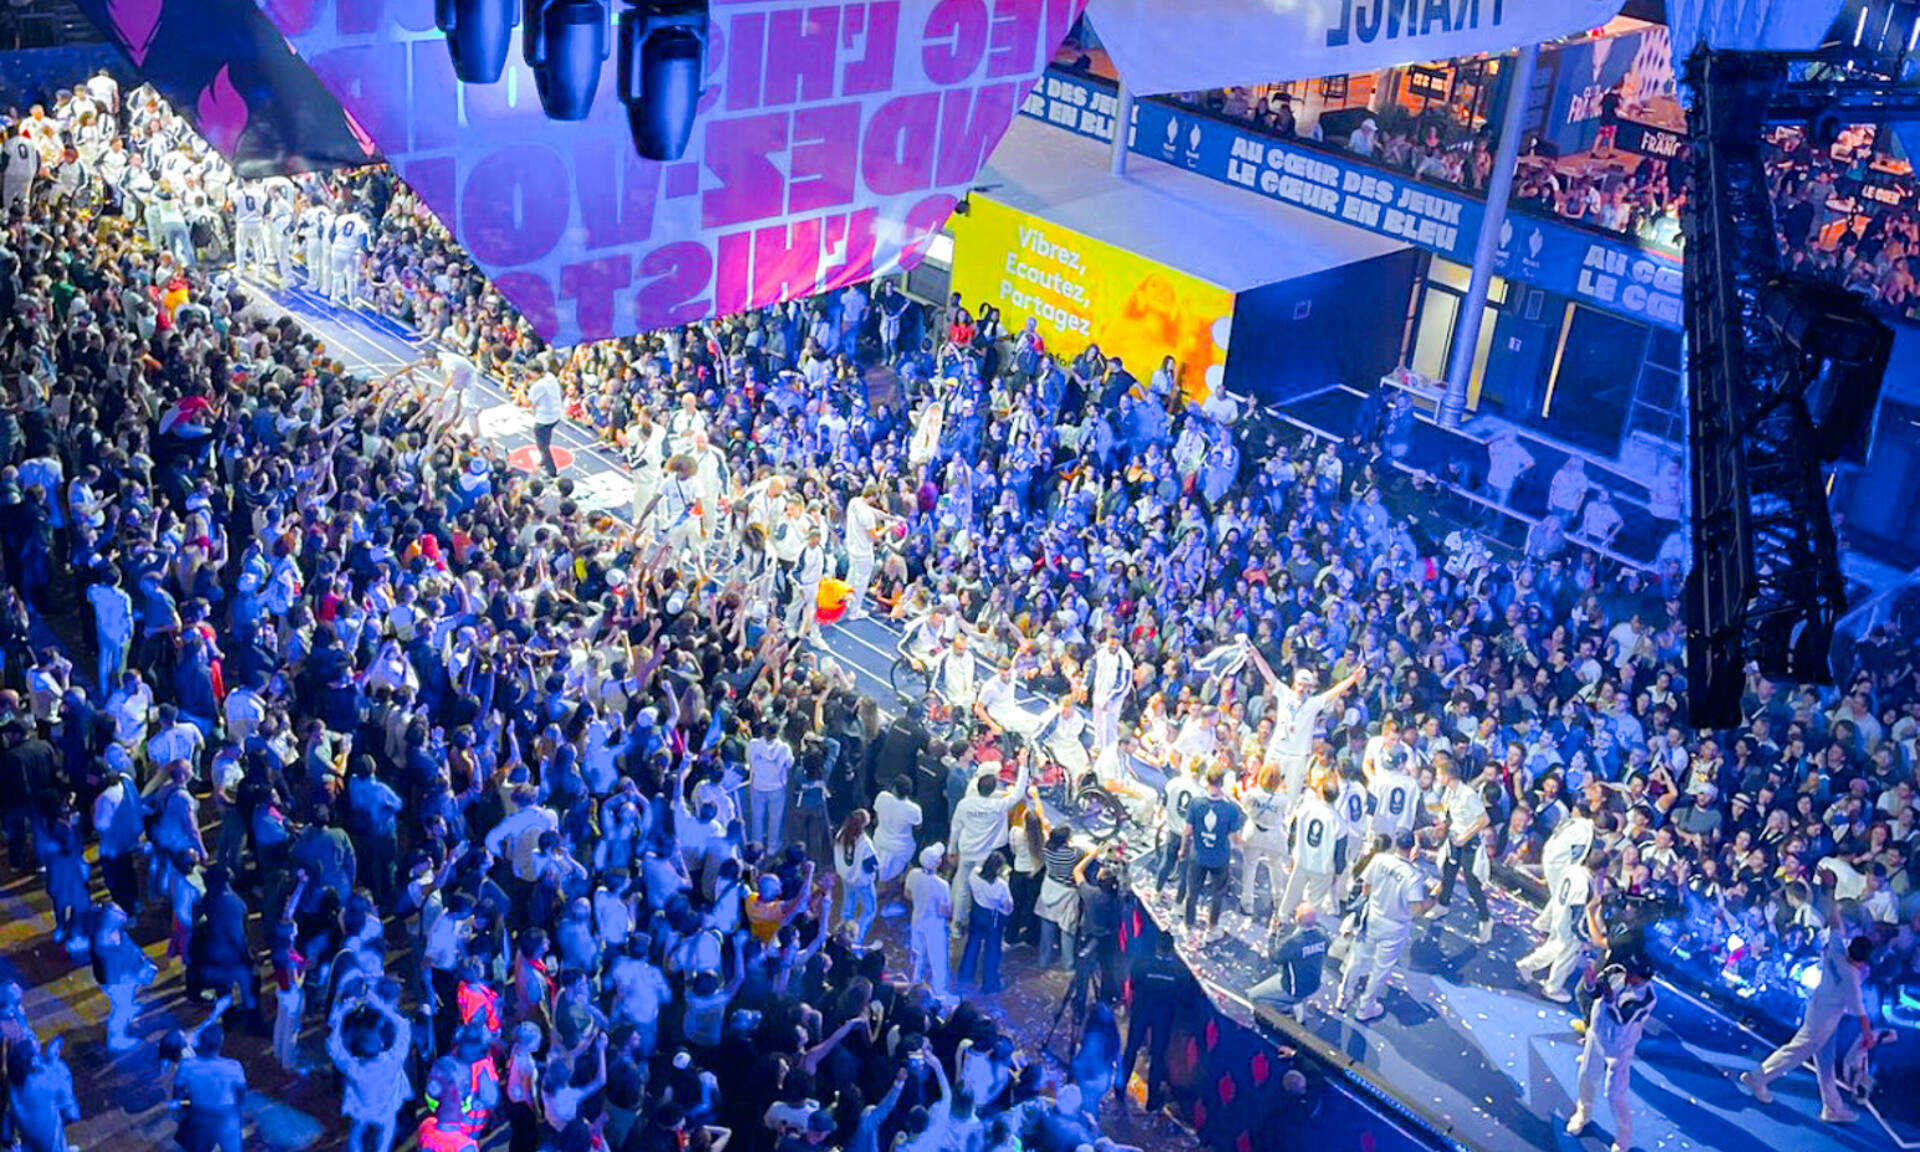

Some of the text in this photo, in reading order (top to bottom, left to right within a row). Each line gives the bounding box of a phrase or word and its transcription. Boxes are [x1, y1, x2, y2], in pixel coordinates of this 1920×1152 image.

[1047, 78, 1088, 107] DES
[1048, 100, 1078, 128] EN
[1227, 158, 1257, 187] LE
[1342, 196, 1381, 227] EN
[1383, 208, 1458, 251] BLEU
[1231, 137, 1264, 165] AU
[1342, 170, 1395, 203] DES
[1398, 188, 1463, 226] JEUX
[1018, 225, 1086, 276] Vibrez,
[1583, 244, 1629, 277] AU
[1005, 251, 1091, 308] Ecoutez,
[1577, 268, 1618, 302] LE
[1000, 279, 1091, 337] Partagez
